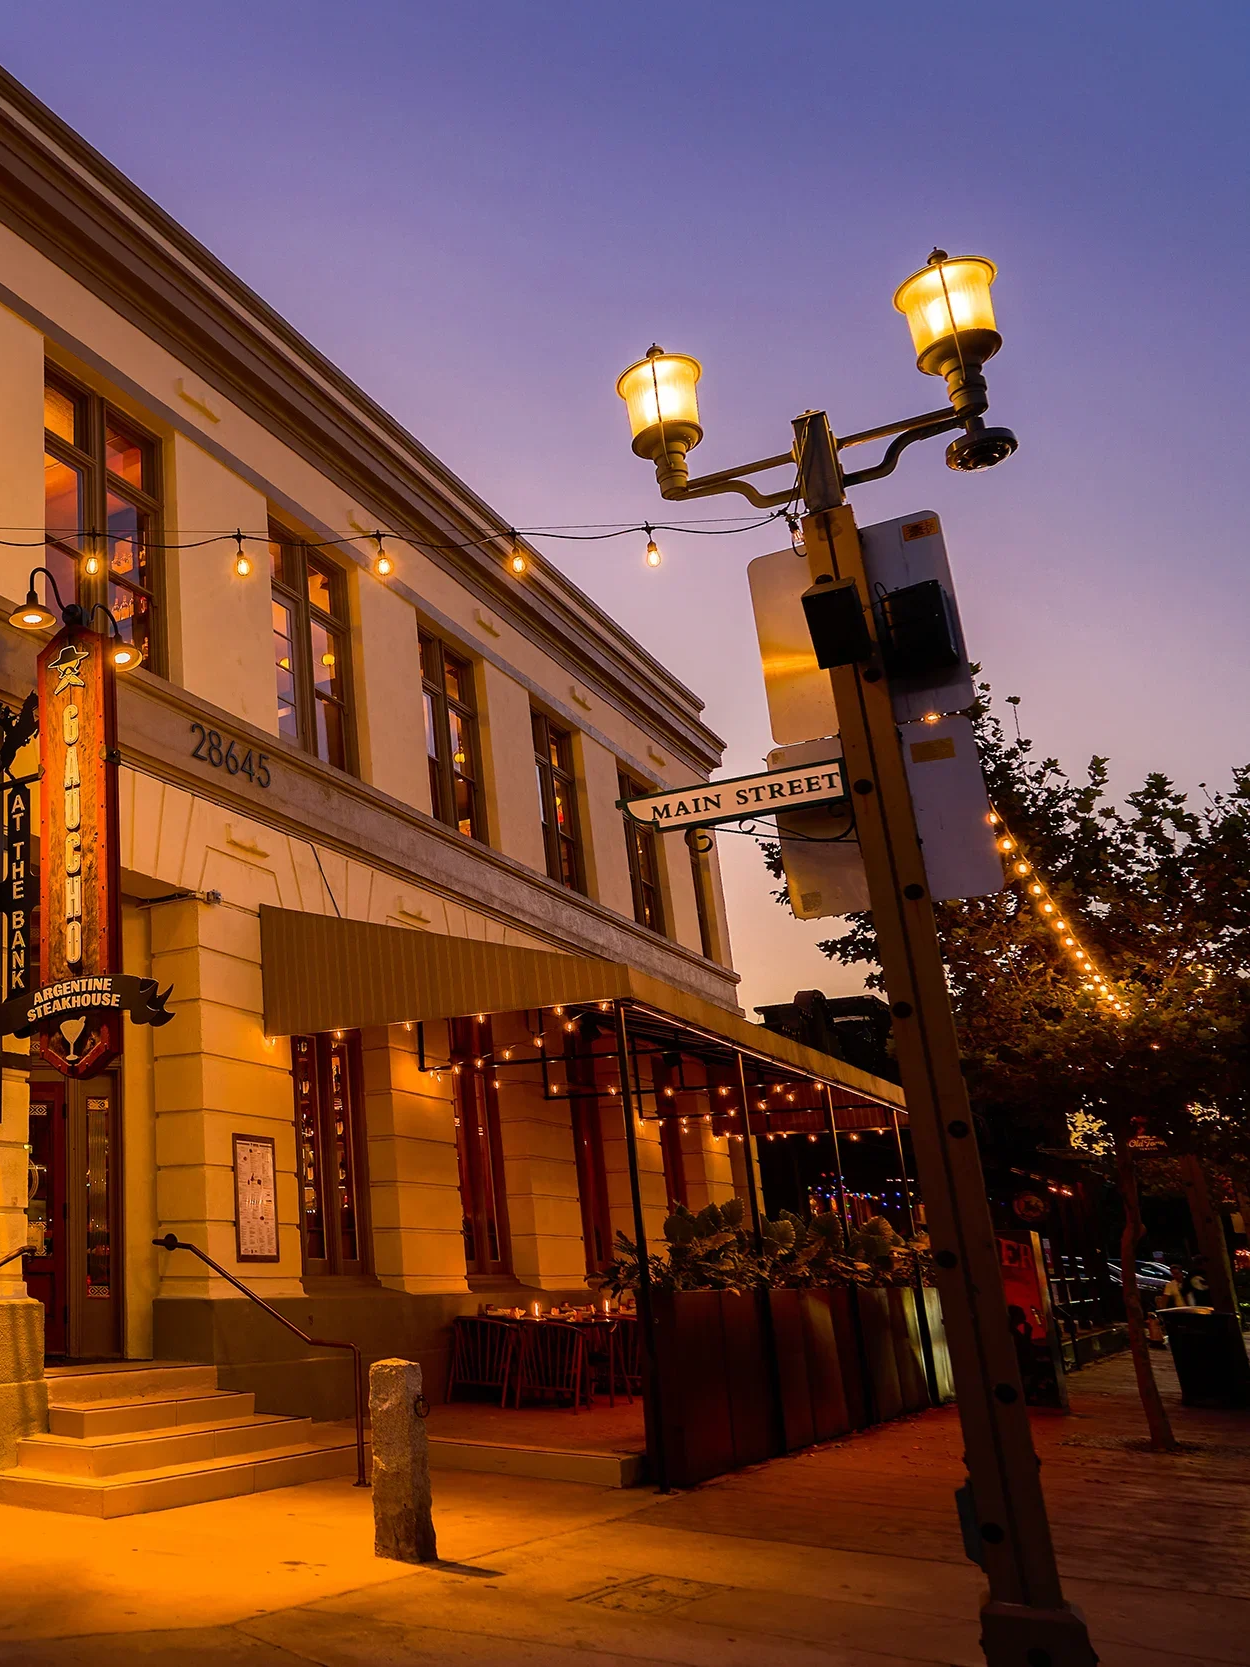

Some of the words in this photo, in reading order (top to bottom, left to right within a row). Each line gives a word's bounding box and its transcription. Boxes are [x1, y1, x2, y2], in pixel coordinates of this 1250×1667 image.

[191, 723, 270, 788] 28645
[11, 794, 26, 832] AT
[651, 793, 722, 821] MAIN
[736, 771, 840, 806] STREET
[62, 703, 81, 964] GAUCHO
[11, 841, 25, 900] THE
[10, 910, 26, 989] BANK
[27, 992, 121, 1022] STEAKHOUSE
[33, 977, 112, 1006] ARGENTINE
